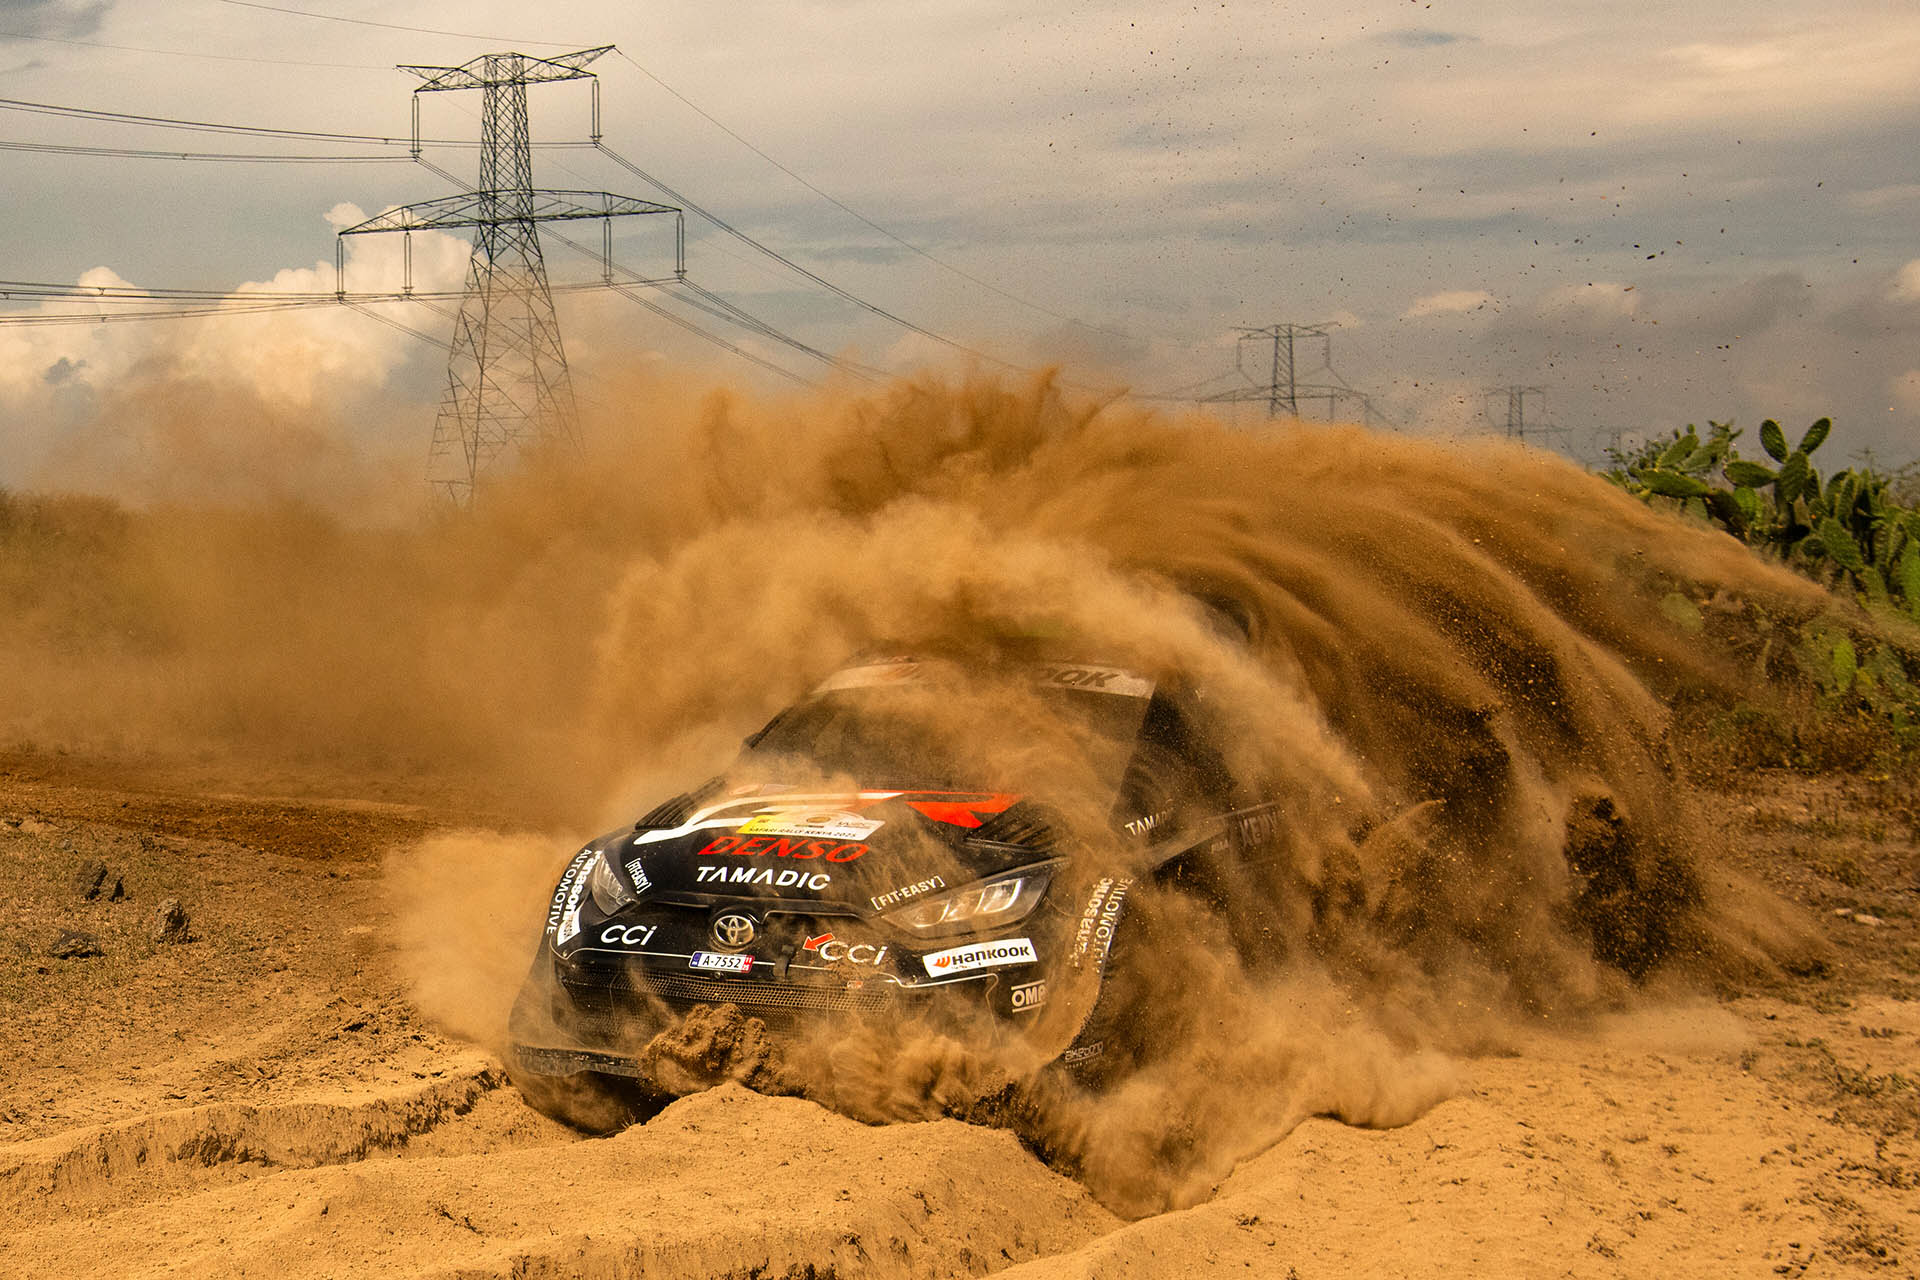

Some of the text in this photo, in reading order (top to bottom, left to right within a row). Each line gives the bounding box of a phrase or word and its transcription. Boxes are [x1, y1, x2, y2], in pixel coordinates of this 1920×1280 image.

[698, 836, 870, 863] DENSO
[547, 849, 592, 934] AUTOMOTIVE
[696, 866, 831, 891] TAMADIC
[702, 955, 741, 968] A-7552
